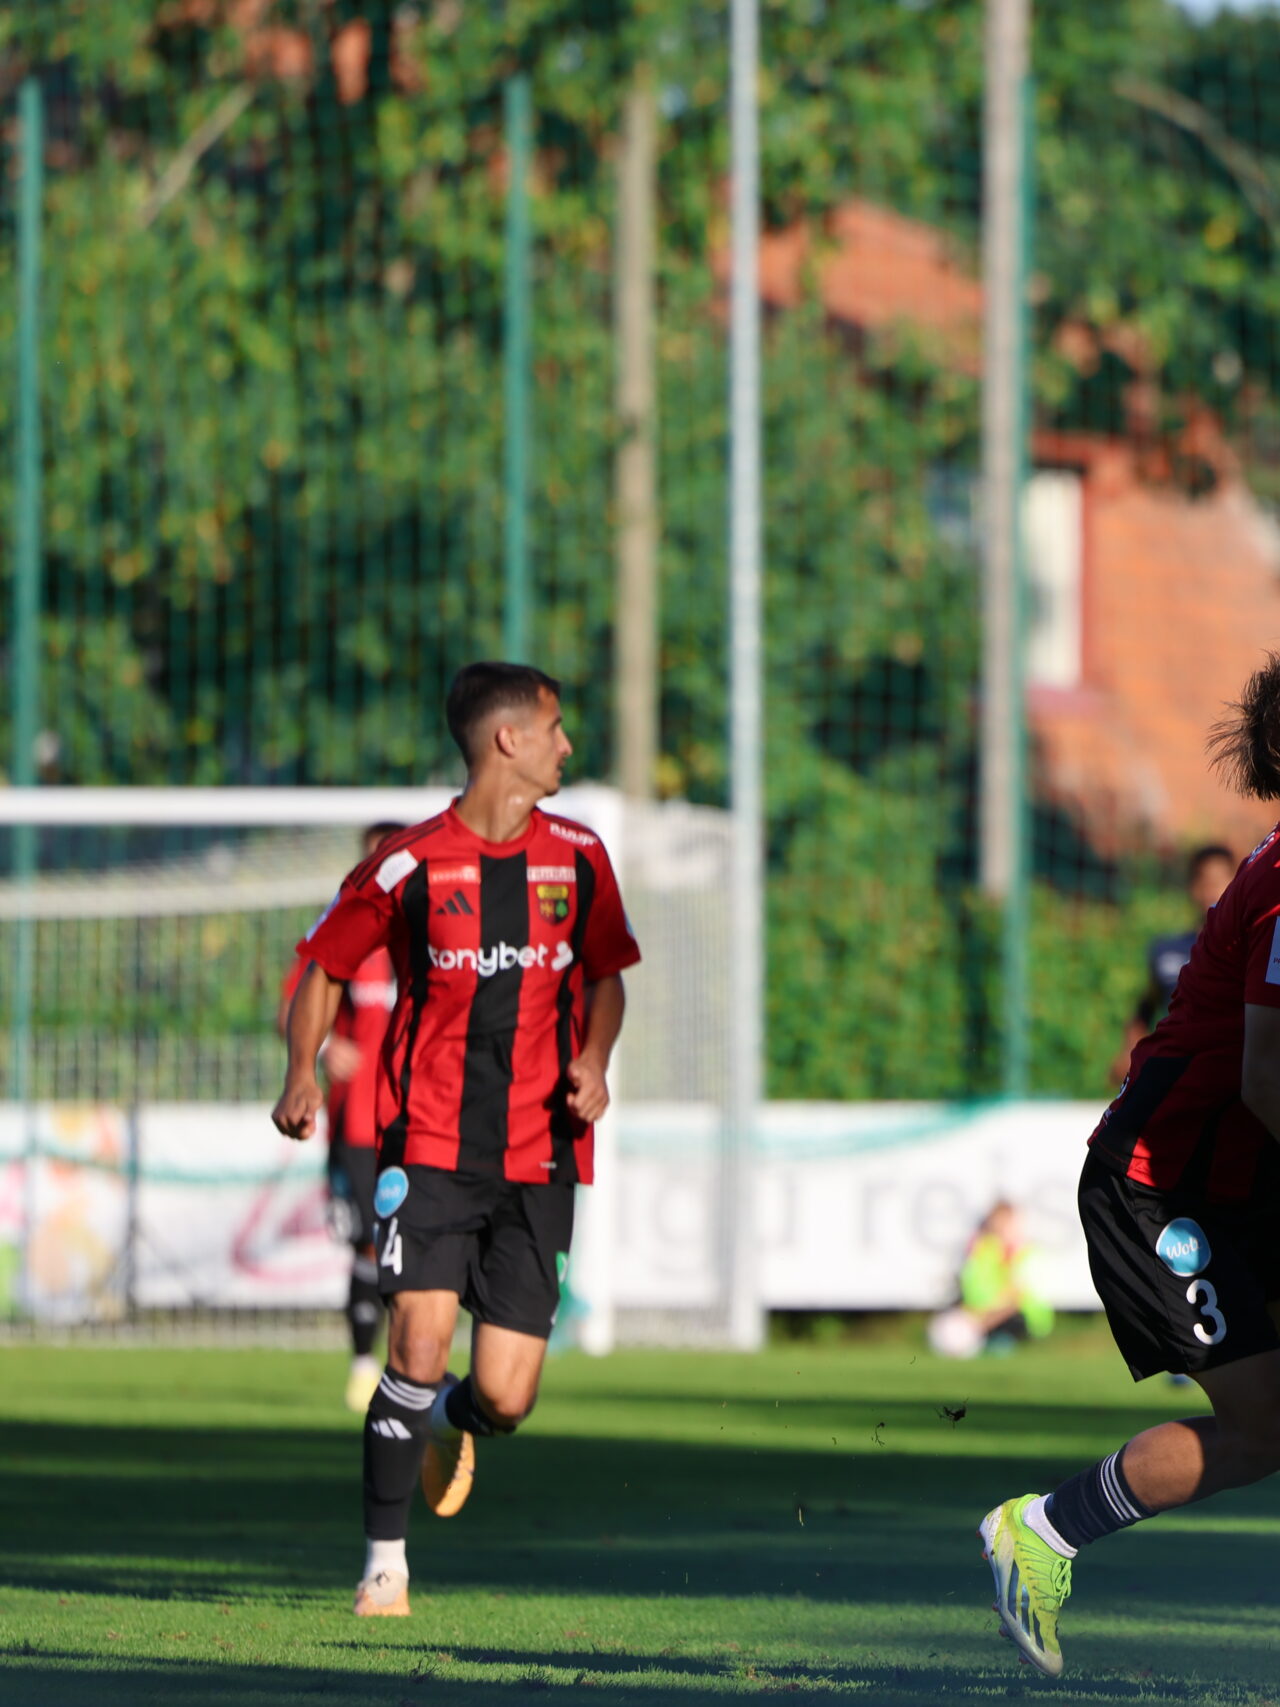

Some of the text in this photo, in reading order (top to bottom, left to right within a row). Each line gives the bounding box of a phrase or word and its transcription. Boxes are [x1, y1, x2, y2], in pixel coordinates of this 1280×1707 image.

[427, 940, 548, 977] tonybet
[381, 1217, 402, 1275] 4
[1186, 1279, 1227, 1345] 3
